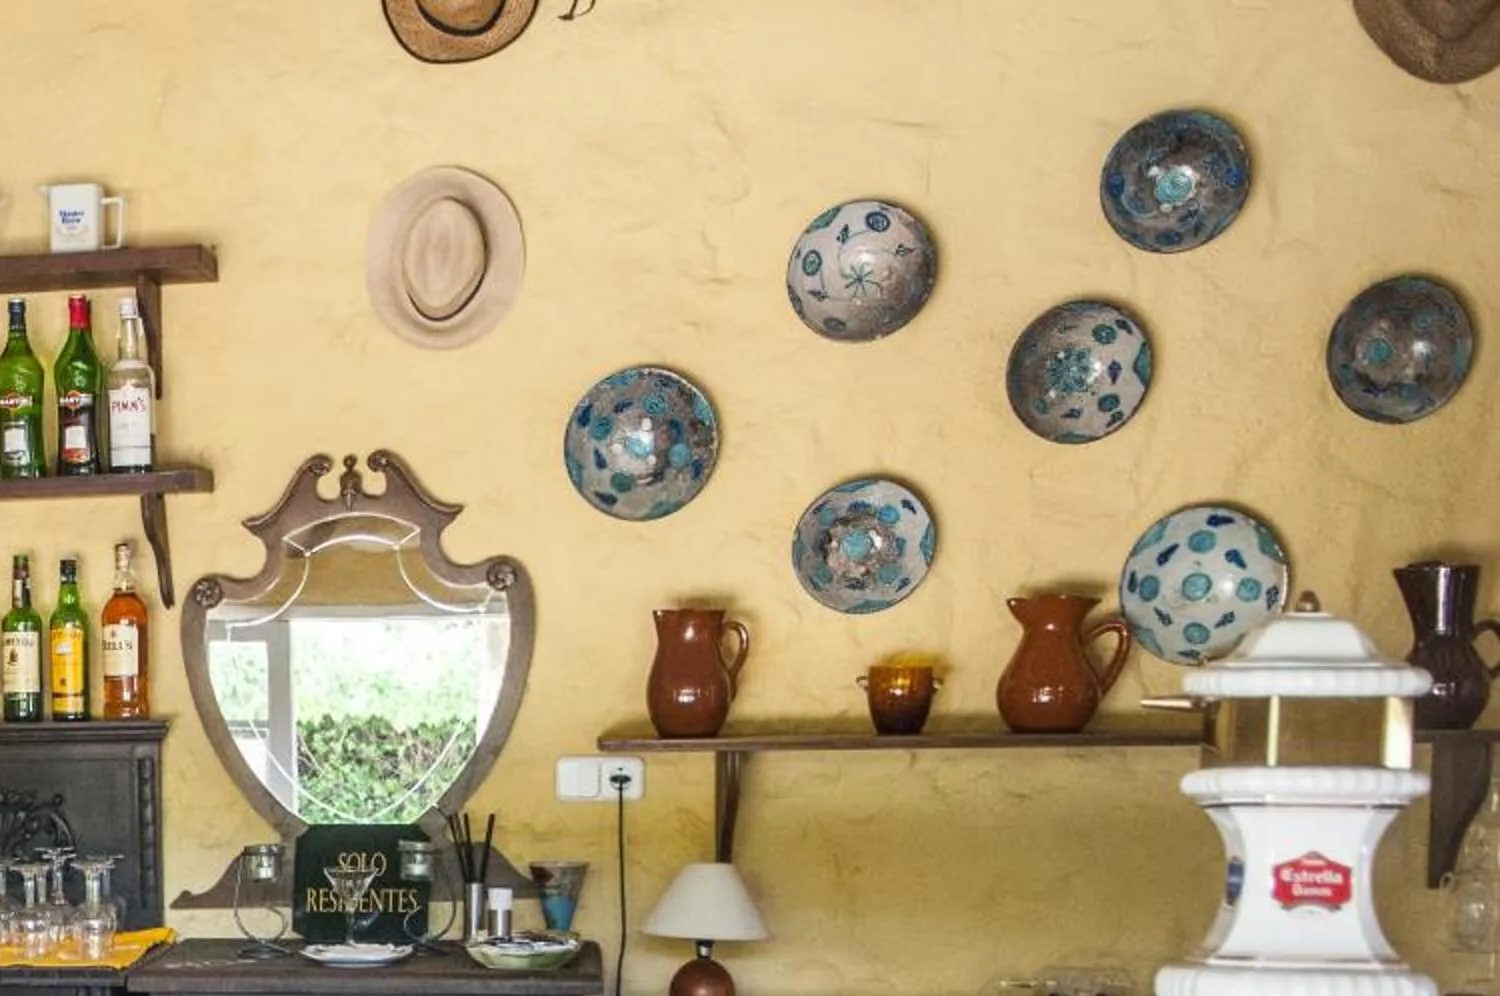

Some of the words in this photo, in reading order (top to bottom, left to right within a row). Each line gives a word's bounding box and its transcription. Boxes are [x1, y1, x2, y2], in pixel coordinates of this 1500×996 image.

[112, 397, 146, 414] PIMM'S
[338, 852, 387, 877] SOLO
[1281, 867, 1343, 885] Estrella
[306, 887, 418, 914] RESIENTES
